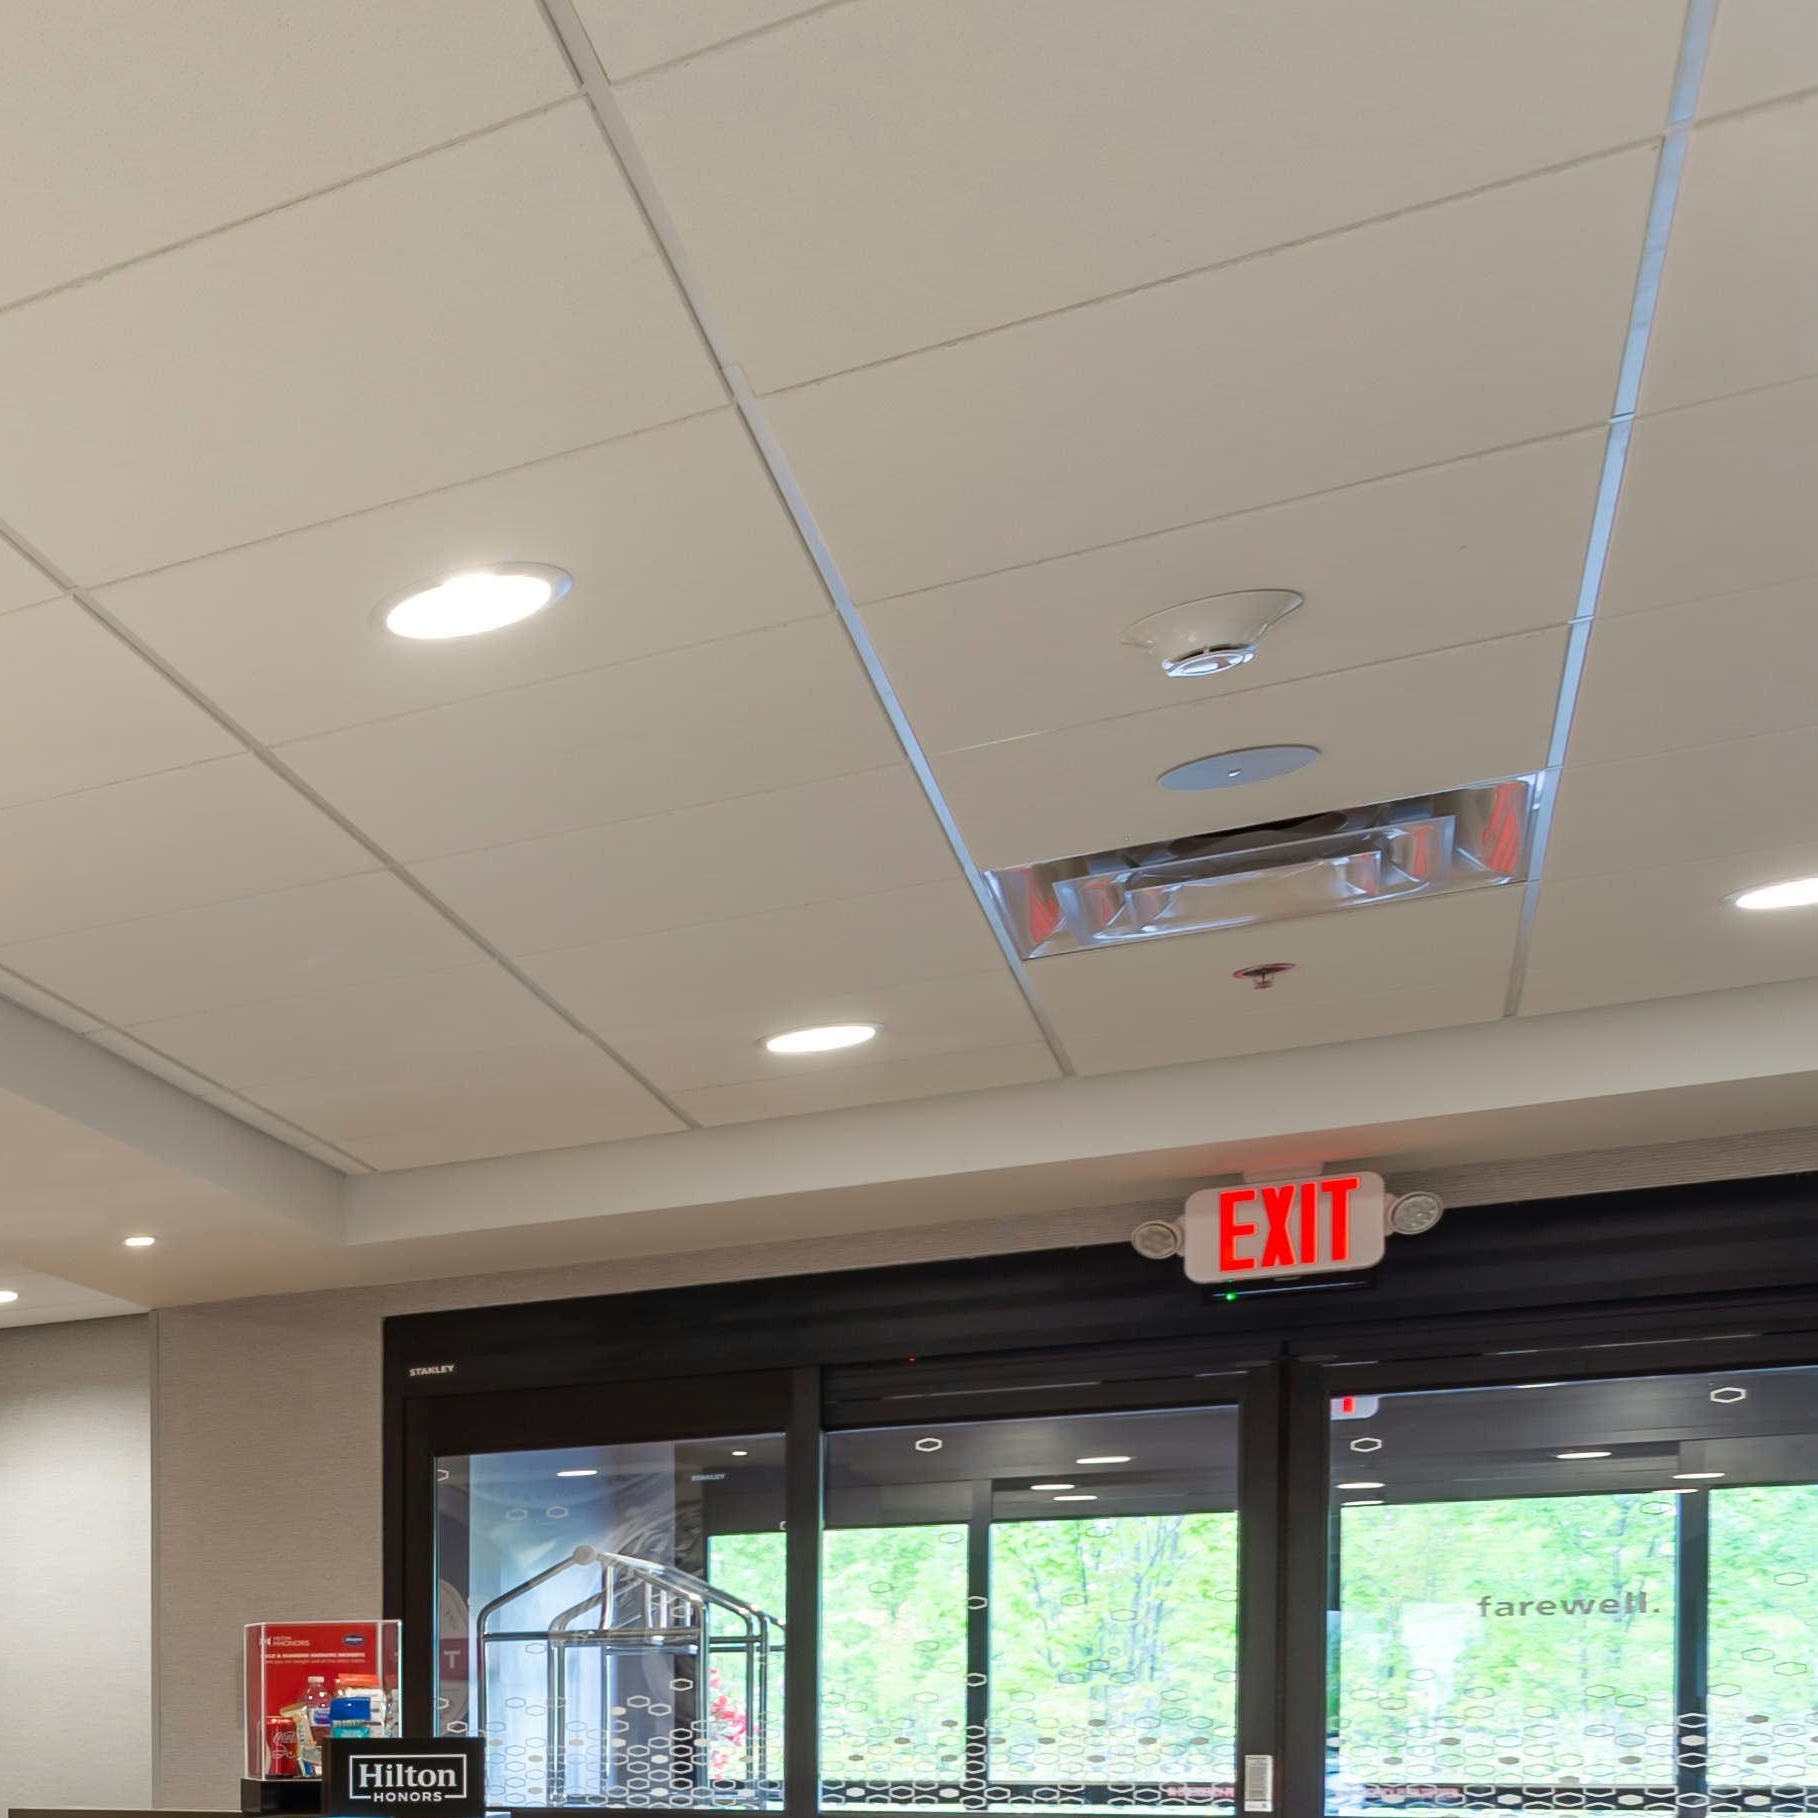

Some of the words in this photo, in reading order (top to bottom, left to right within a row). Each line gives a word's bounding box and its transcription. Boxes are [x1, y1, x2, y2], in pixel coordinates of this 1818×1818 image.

[1219, 1176, 1361, 1272] EXIT
[1476, 1591, 1661, 1618] farewell.
[358, 1763, 458, 1788] Hilton
[373, 1791, 444, 1803] HONORS
